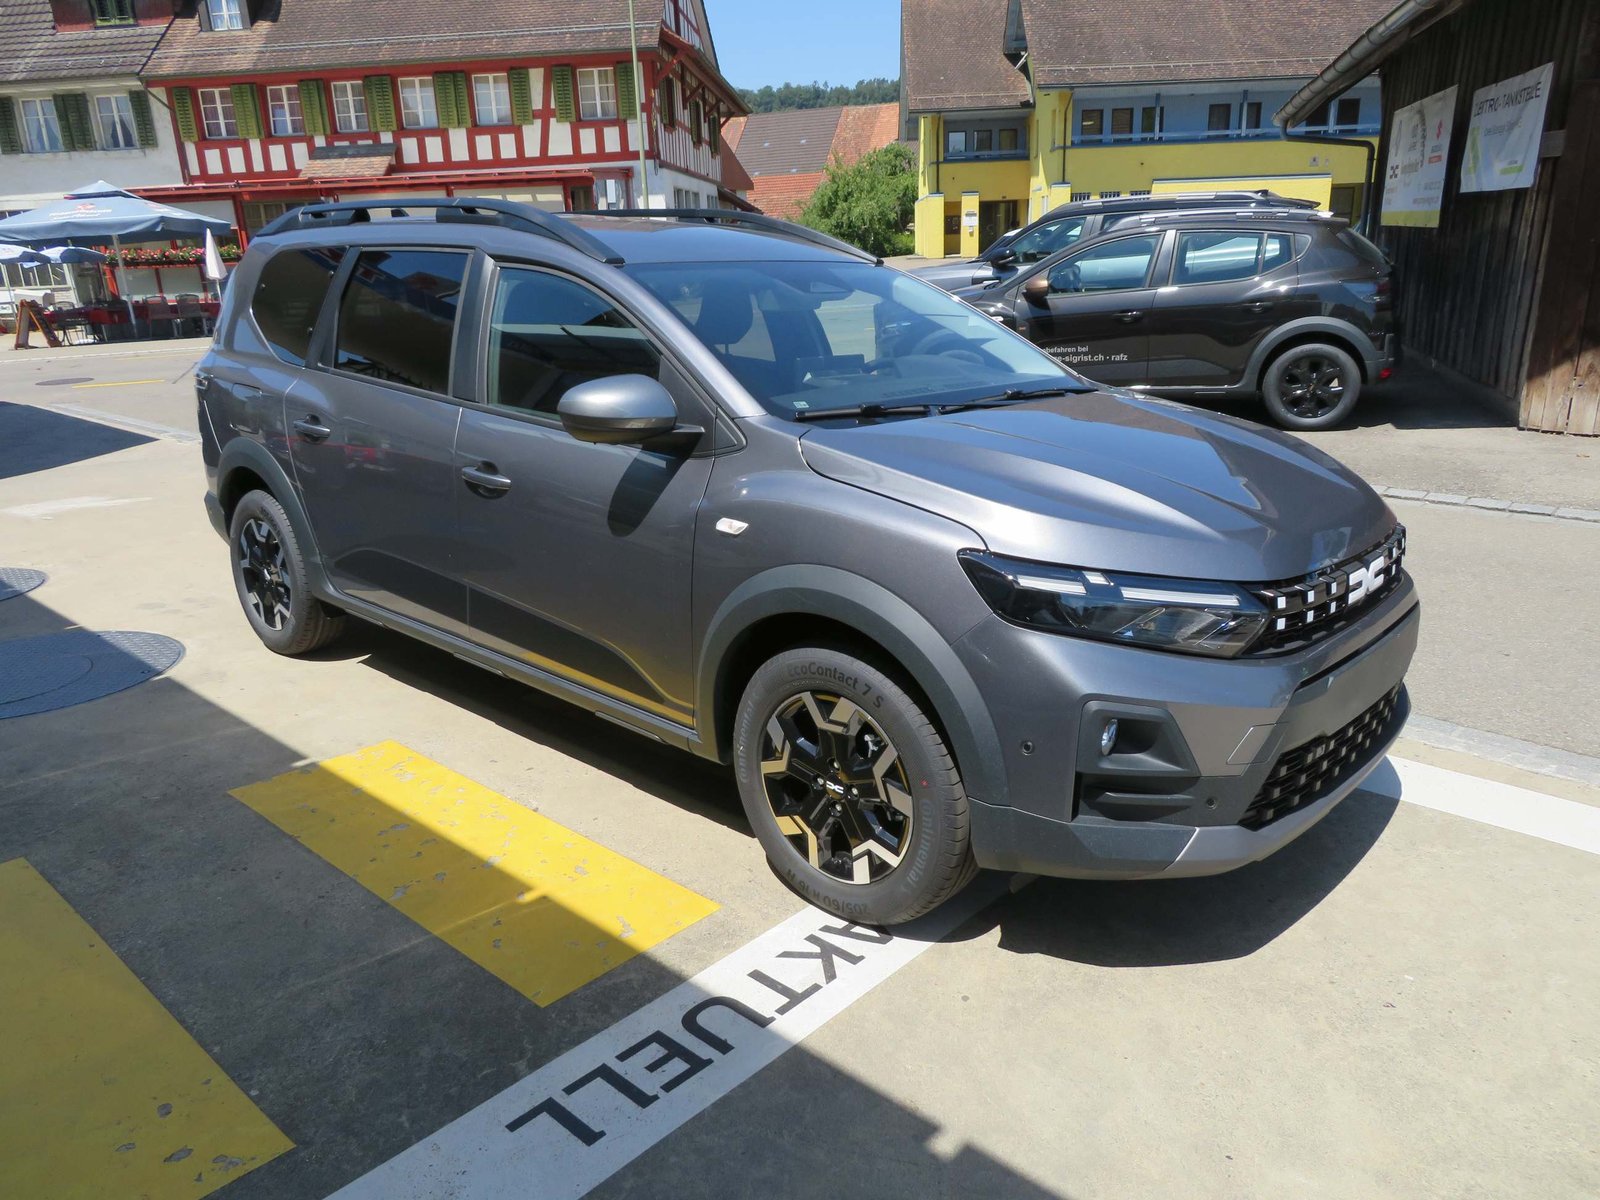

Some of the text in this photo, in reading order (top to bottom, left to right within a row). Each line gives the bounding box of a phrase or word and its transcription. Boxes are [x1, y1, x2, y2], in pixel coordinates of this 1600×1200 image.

[1078, 345, 1089, 353] bei
[1111, 353, 1128, 361] rafz
[787, 662, 884, 708] EcoContact 7 S
